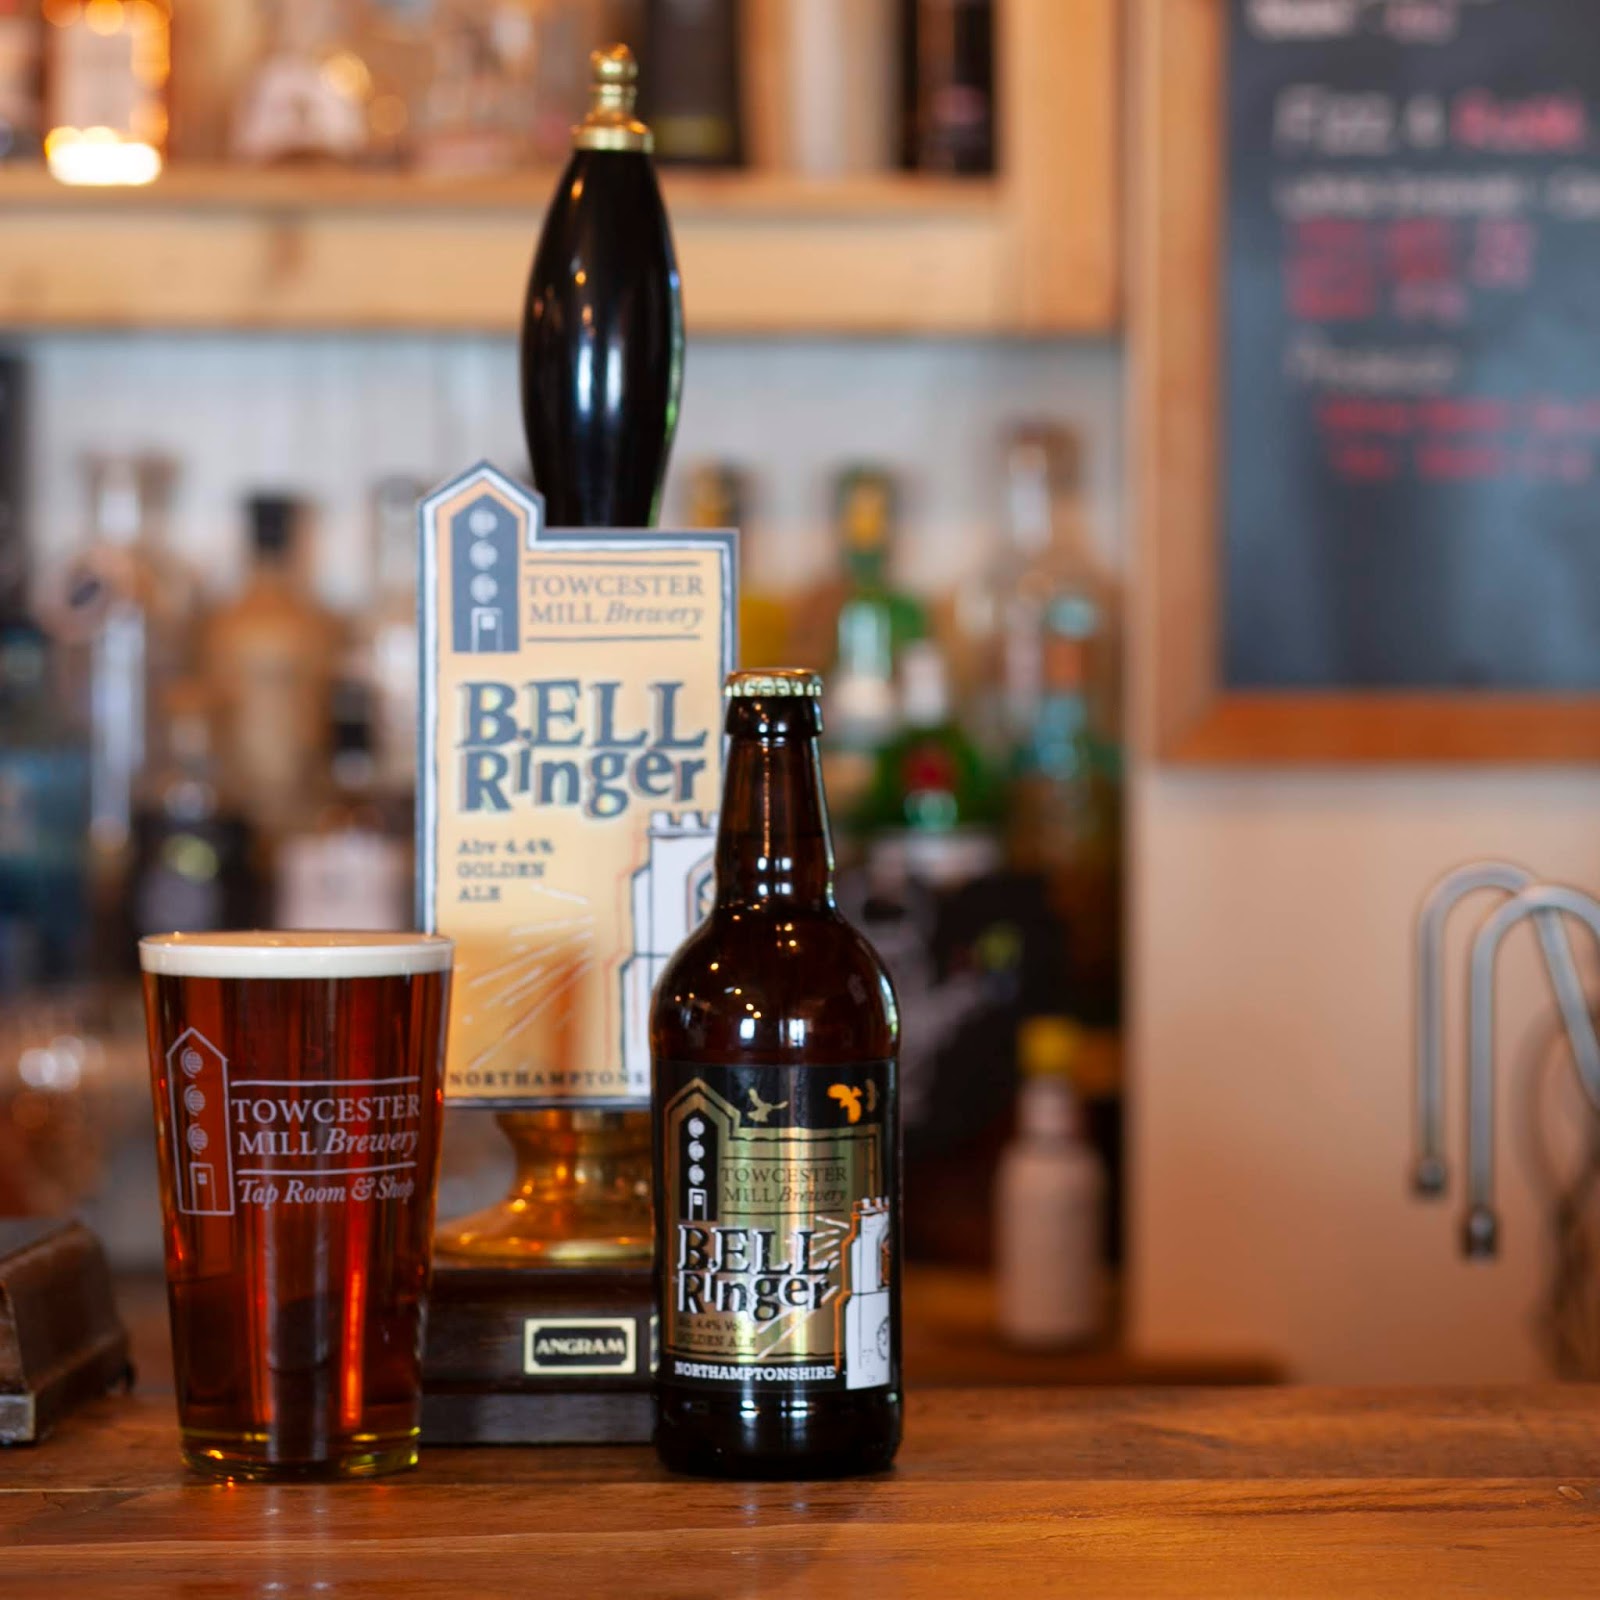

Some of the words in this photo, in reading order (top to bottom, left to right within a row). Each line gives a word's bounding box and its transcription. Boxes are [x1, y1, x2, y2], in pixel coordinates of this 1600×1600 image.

[527, 575, 704, 597] TOWCESTER
[529, 602, 599, 625] MILL
[605, 600, 704, 630] Brewery
[457, 679, 708, 749] BELL
[457, 861, 545, 879] GOLDEN
[457, 886, 501, 903] ALE
[230, 1094, 421, 1124] TOWCESTER
[237, 1131, 318, 1156] MILL
[322, 1127, 420, 1158] Brewery
[720, 1166, 847, 1184] TOWCESTER
[237, 1179, 279, 1211] Tap
[283, 1179, 346, 1204] Room
[350, 1176, 376, 1201] &
[375, 1175, 415, 1203] Shop
[724, 1187, 775, 1203] MILL
[777, 1186, 846, 1207] Brewery
[678, 1224, 832, 1275] BELL
[535, 1337, 625, 1355] ANGRAM
[674, 1361, 837, 1381] NORTHAMPTONSHIRE
